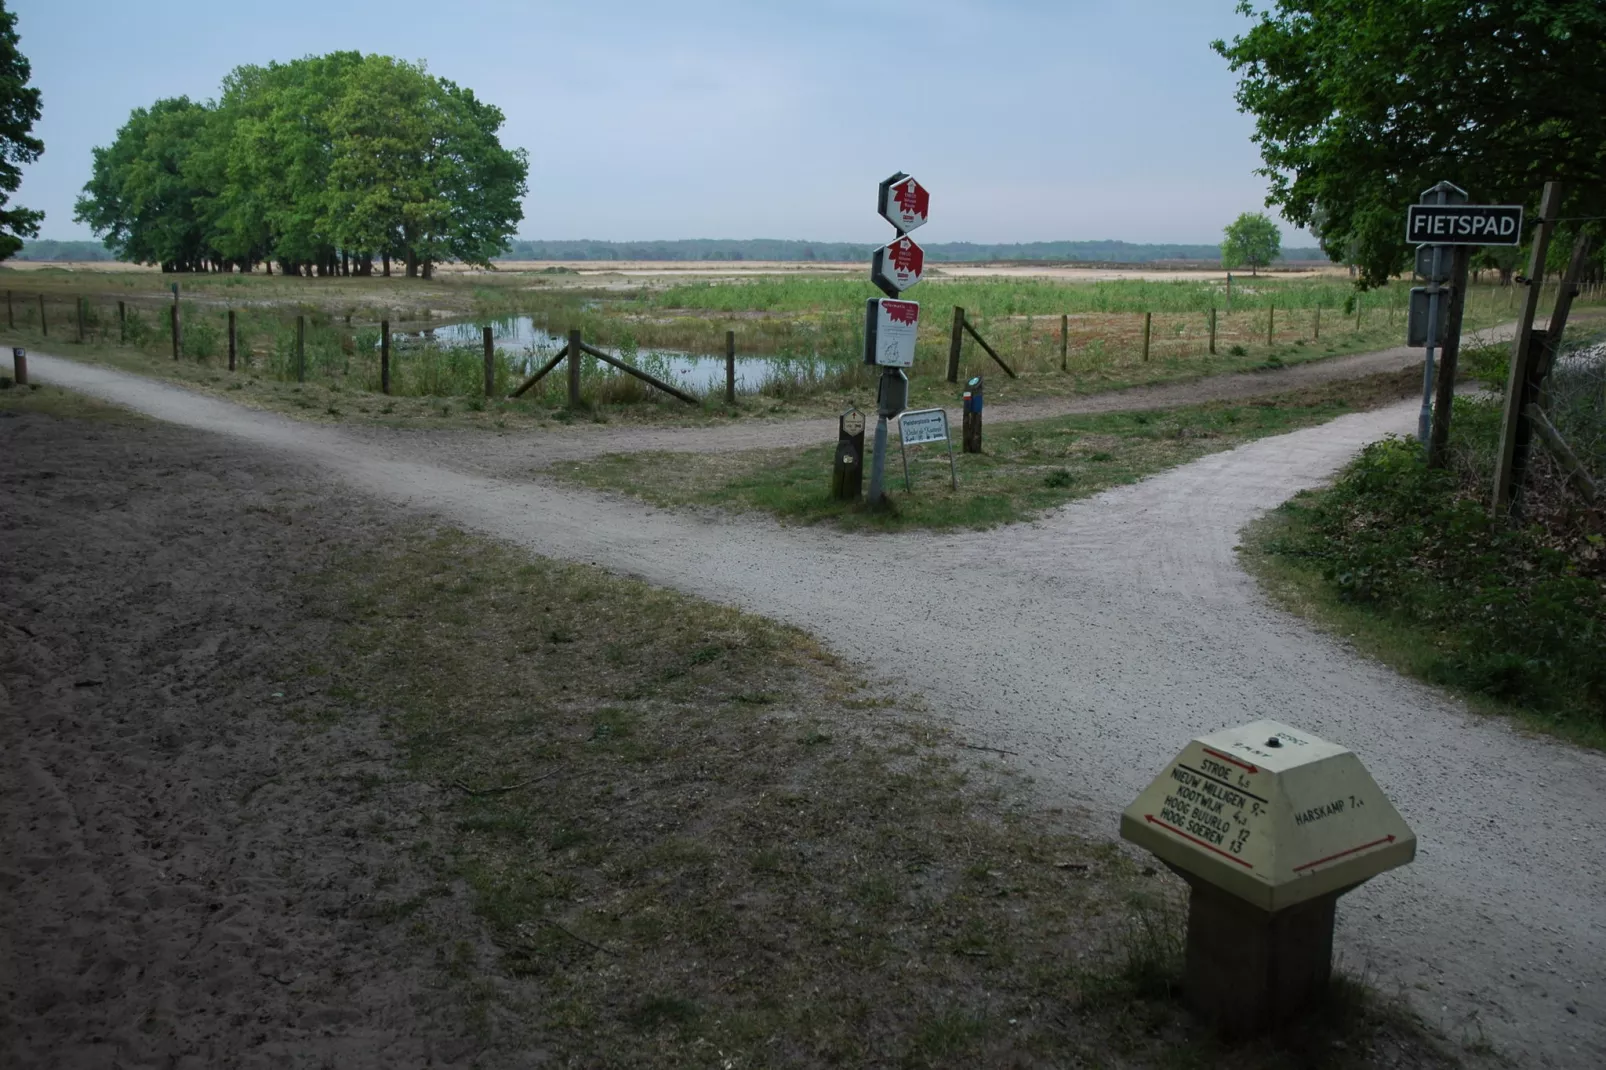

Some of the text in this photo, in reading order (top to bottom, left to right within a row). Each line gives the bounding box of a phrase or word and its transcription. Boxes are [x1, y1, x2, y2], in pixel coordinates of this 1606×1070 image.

[1414, 215, 1515, 236] FIETSPAD
[1201, 759, 1233, 780] STROE
[1170, 768, 1202, 788] NIEUW
[1202, 780, 1246, 808] MILLIGEN
[1176, 785, 1224, 815] KOOTWIJK
[1164, 795, 1250, 842] HOOG BUURLO 12
[1294, 800, 1345, 826] HARSKAMP
[1160, 807, 1244, 854] HOOG SOEREN 13
